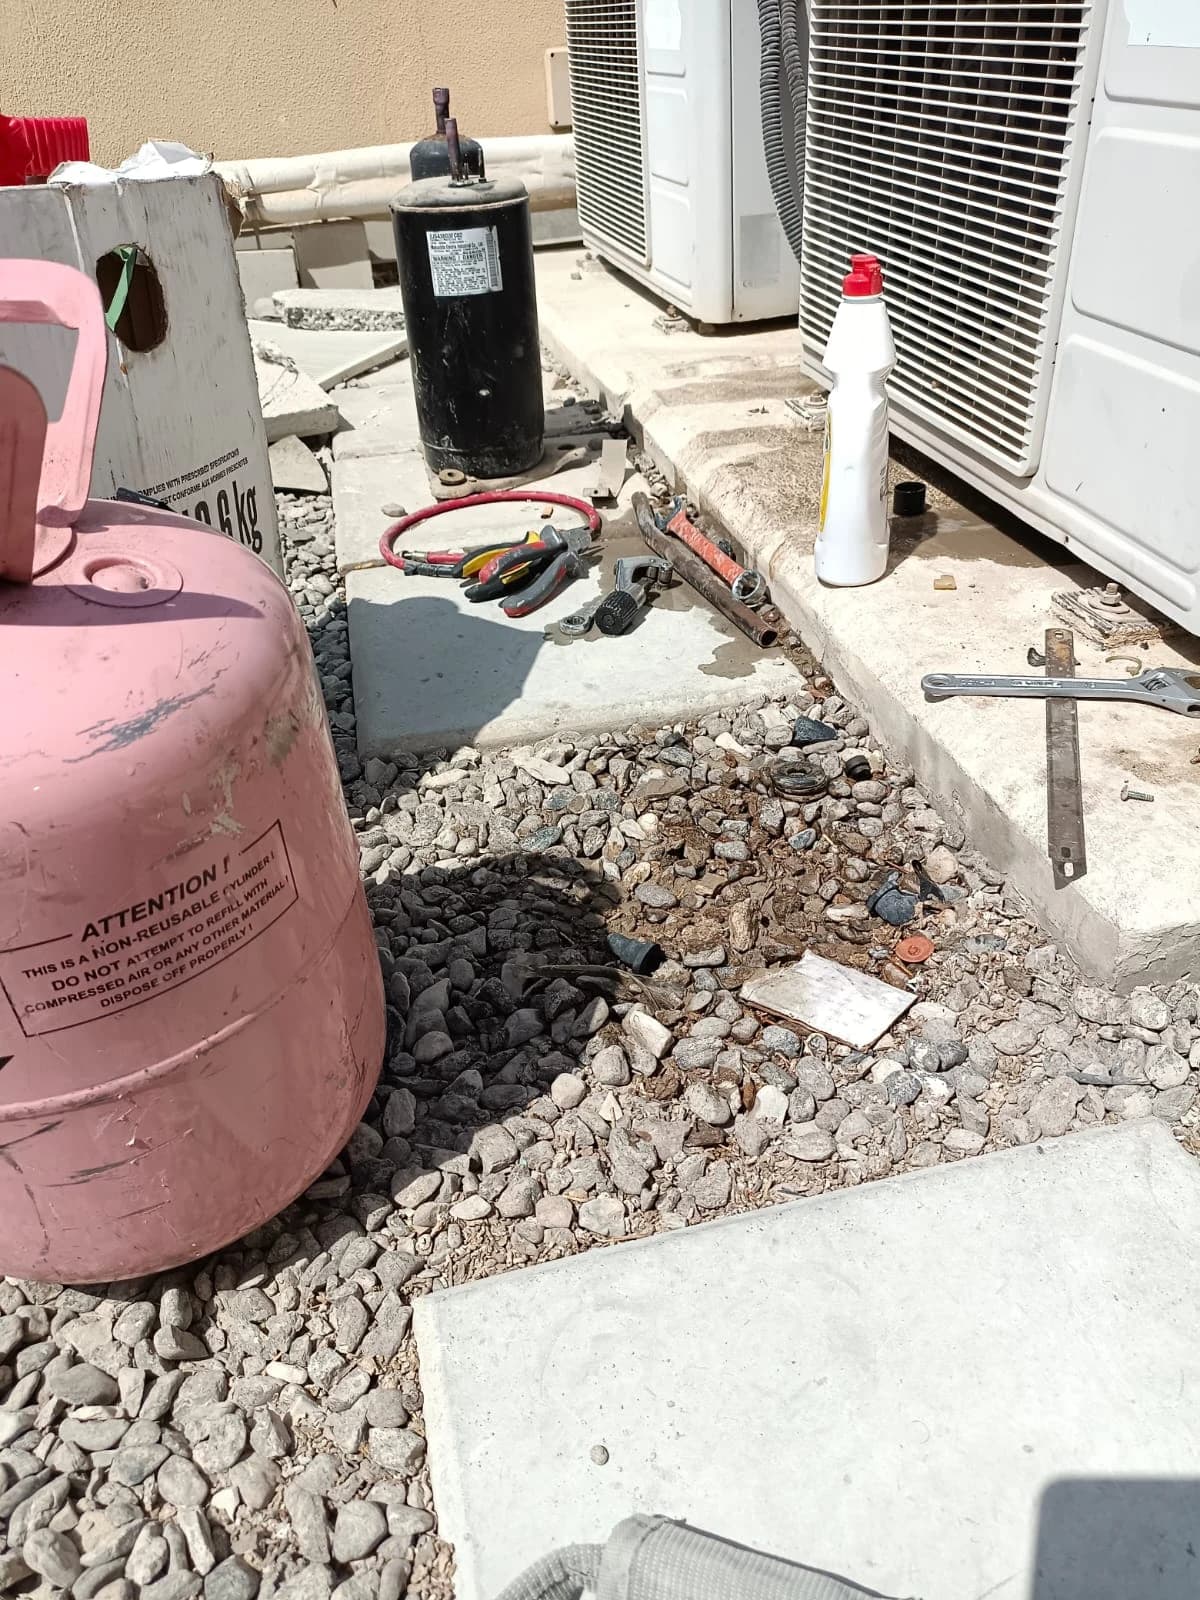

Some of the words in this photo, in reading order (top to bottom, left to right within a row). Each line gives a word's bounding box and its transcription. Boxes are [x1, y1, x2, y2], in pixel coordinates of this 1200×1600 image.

[165, 477, 181, 490] WITH
[181, 465, 210, 484] PRESCRIBED
[172, 483, 201, 502] CONFORME
[22, 962, 58, 980] THIS
[60, 957, 75, 971] IS
[79, 954, 91, 965] A
[92, 891, 220, 960] NON-REUSABLE
[52, 976, 80, 992] DO
[85, 962, 121, 982] NOT
[127, 933, 185, 967] ATTEMPT
[188, 923, 204, 938] TO
[206, 902, 243, 928] REFILL
[243, 879, 268, 902] WITH
[81, 864, 217, 943] ATTENTION
[24, 977, 125, 1014] COMPRESSED
[128, 967, 151, 983] AIR
[154, 957, 173, 971] OR
[176, 942, 199, 962] ANY
[202, 917, 240, 946] OTHER
[241, 881, 285, 921] MATERIAL
[100, 979, 160, 1008] DISPOSE
[164, 965, 187, 981] OFF
[189, 930, 247, 970] PROPERLY
